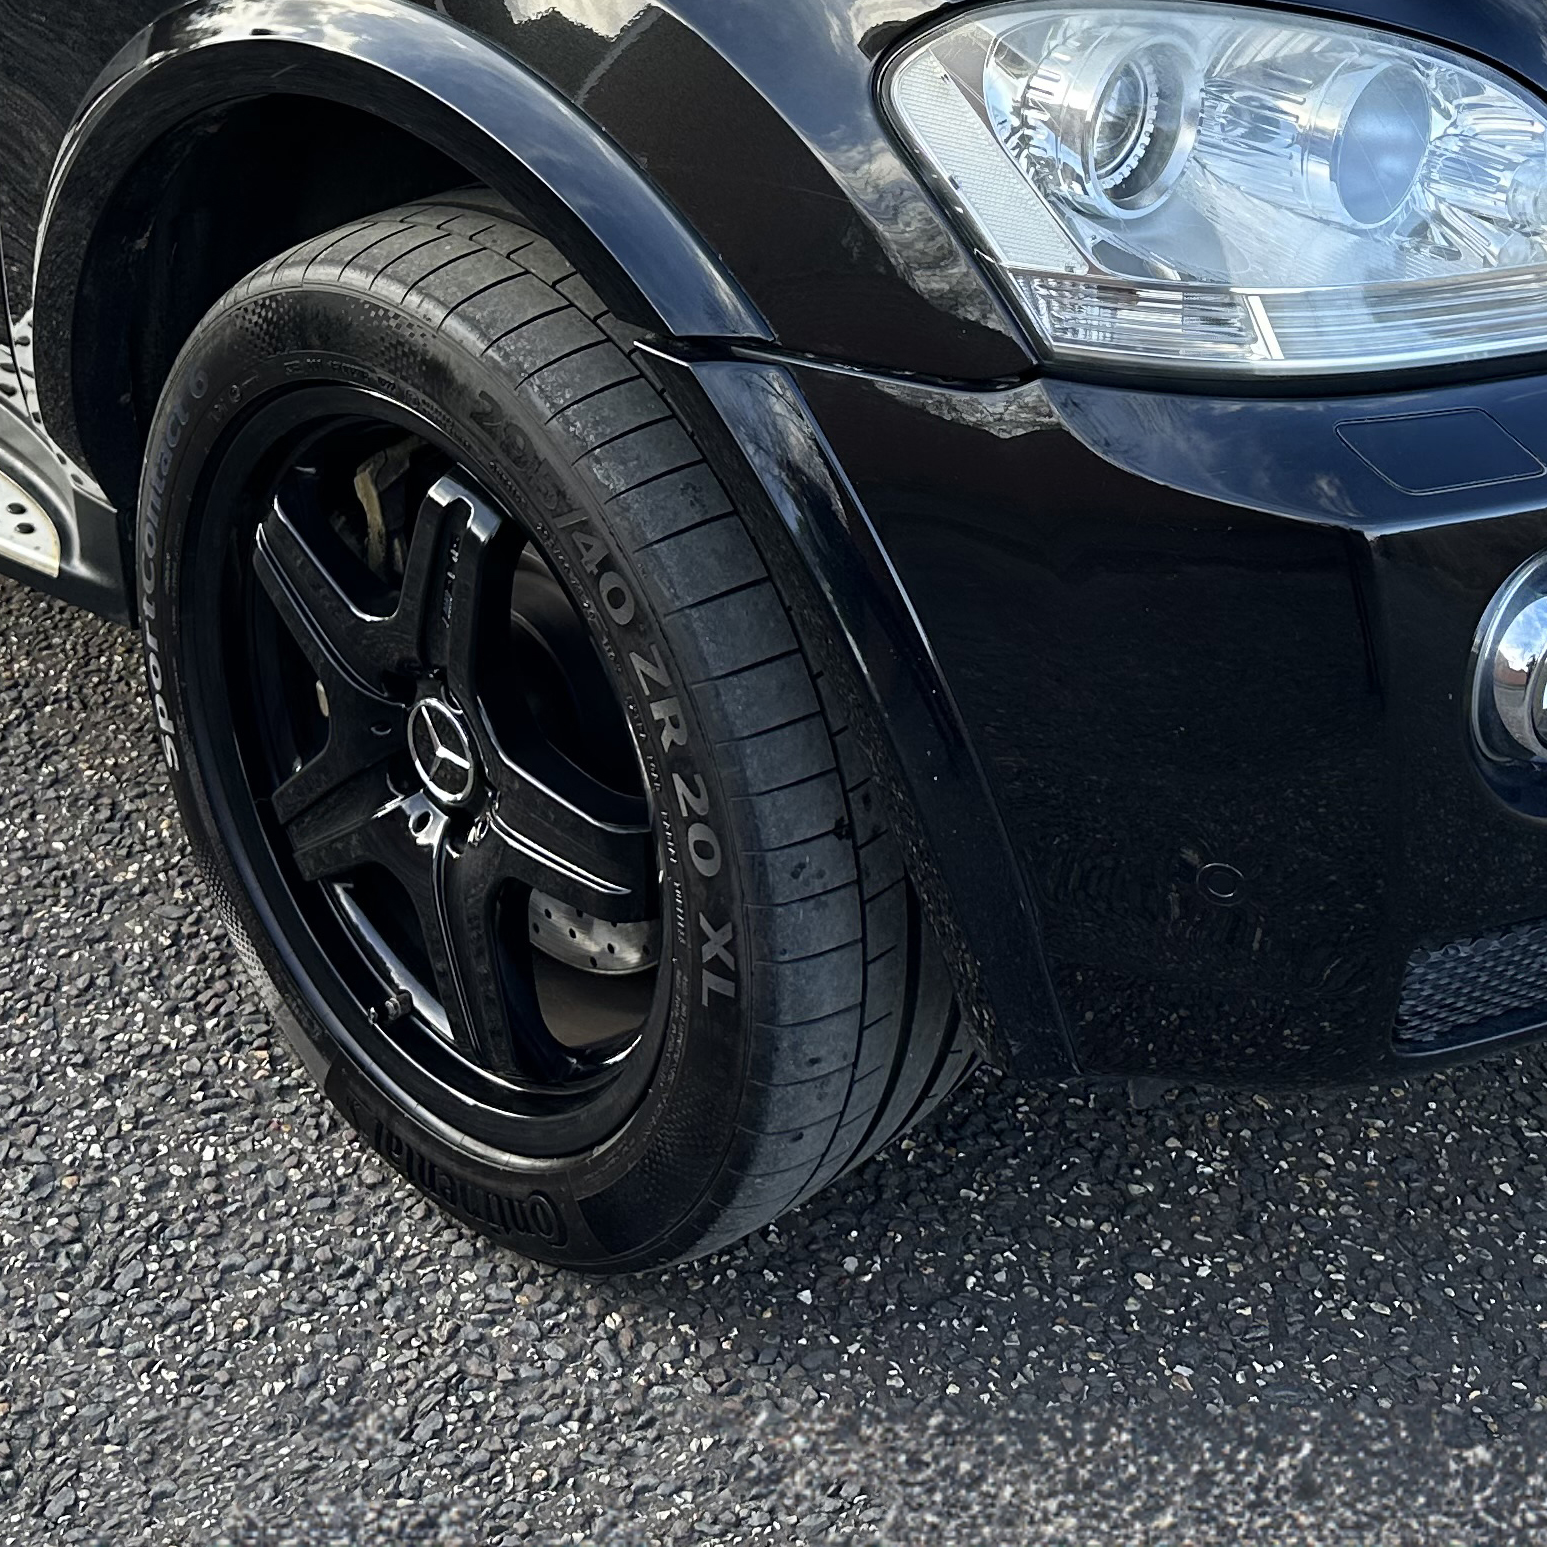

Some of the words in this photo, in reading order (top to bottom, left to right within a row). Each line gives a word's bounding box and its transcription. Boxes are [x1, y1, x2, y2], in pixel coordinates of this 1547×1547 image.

[469, 390, 635, 626] 295/40
[628, 643, 689, 754] ZR
[671, 772, 722, 877] 20
[698, 911, 736, 1007] XL
[374, 1119, 570, 1249] Continental
